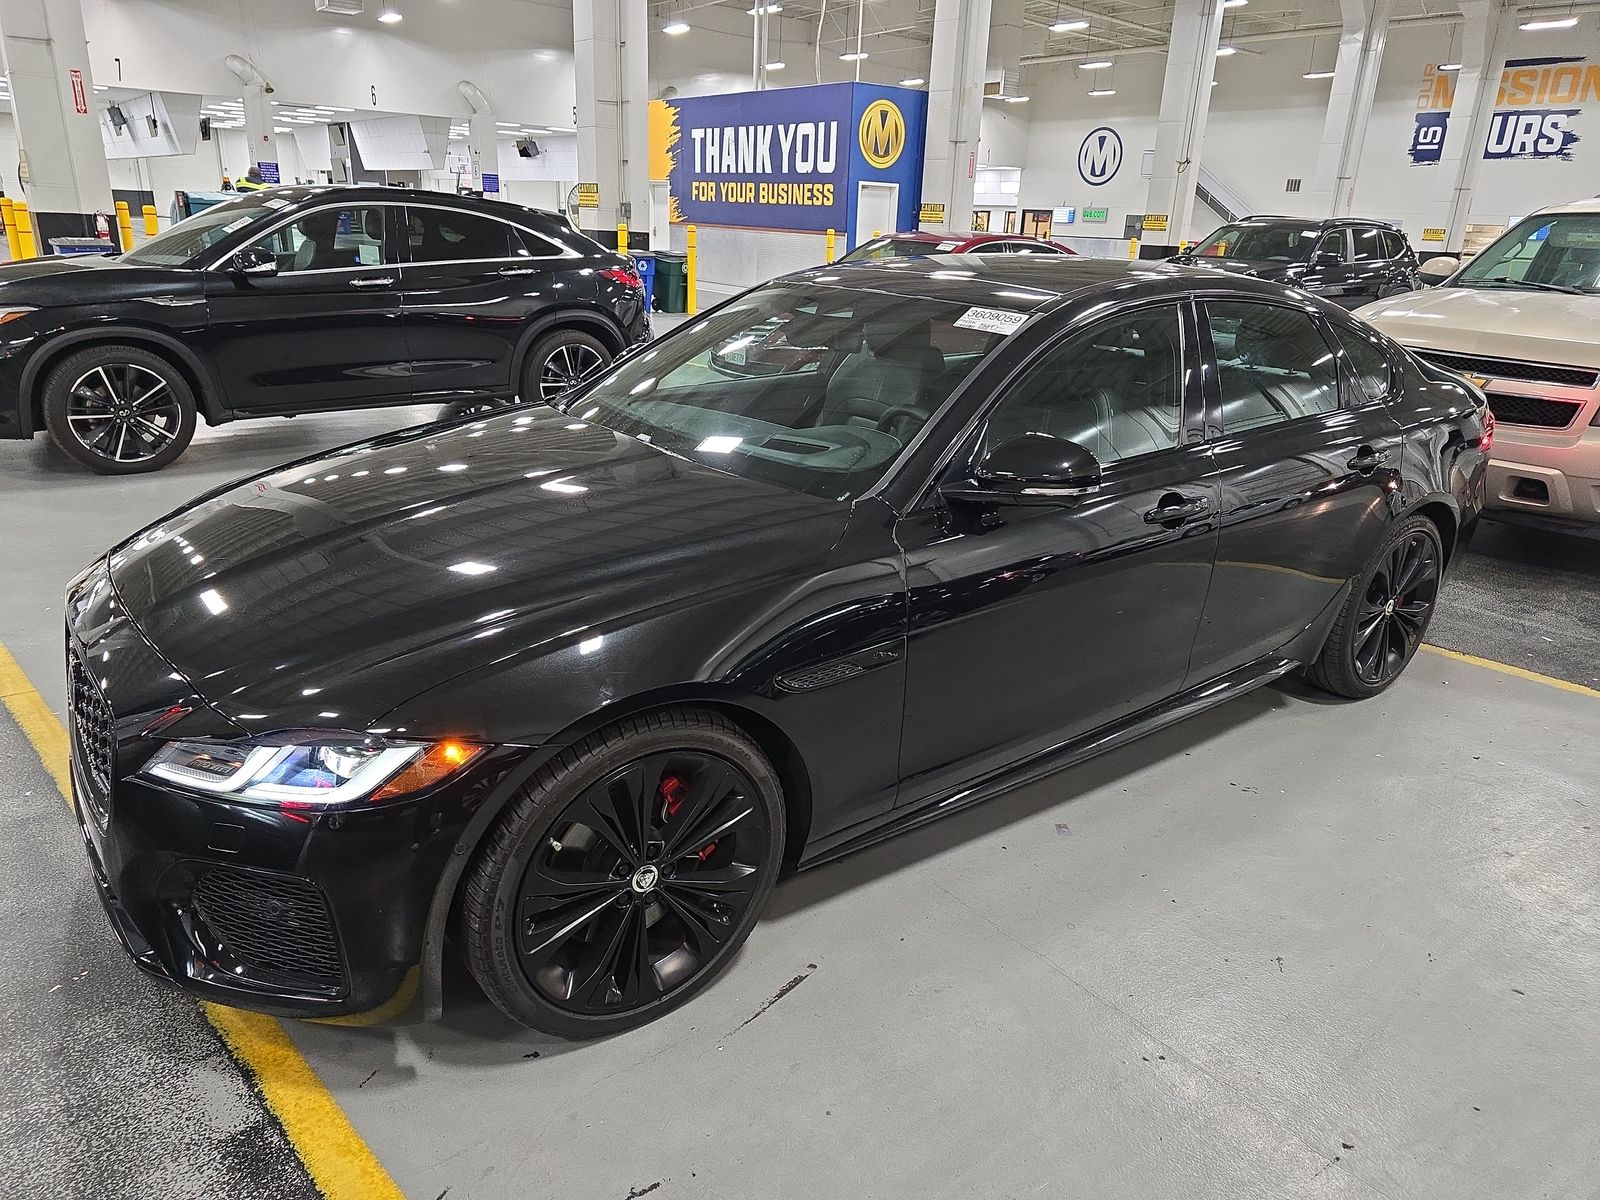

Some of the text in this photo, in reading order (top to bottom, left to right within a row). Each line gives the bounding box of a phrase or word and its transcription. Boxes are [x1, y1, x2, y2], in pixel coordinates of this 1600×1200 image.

[371, 84, 377, 106] 6
[573, 106, 577, 124] 5
[1416, 114, 1567, 154] IS URS
[691, 121, 838, 174] THANK YOU
[691, 181, 834, 206] FOR YOUR BUSINESS
[967, 309, 1023, 324] 3609059
